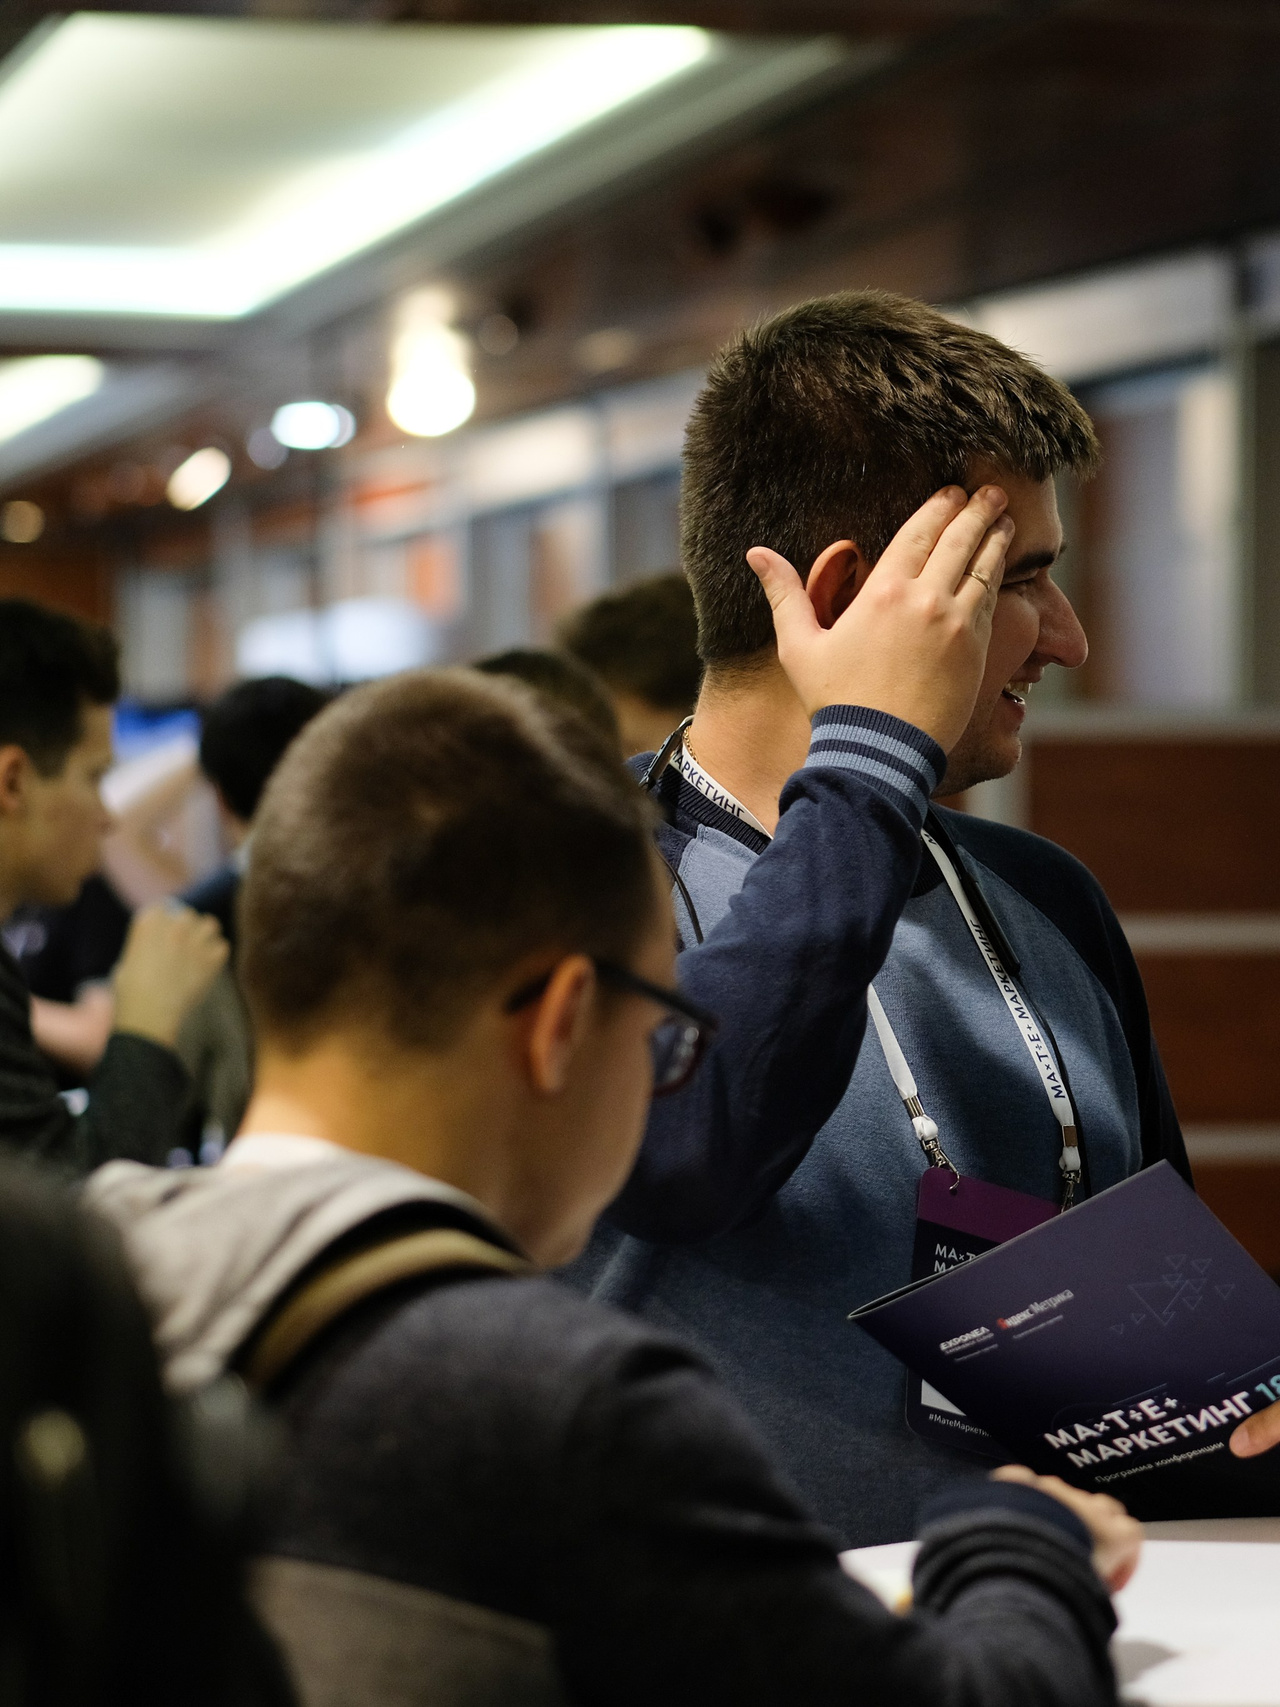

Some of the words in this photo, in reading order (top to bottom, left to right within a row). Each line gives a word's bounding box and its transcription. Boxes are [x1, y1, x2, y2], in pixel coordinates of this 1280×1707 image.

[970, 919, 1029, 1019] МАРКЕТИНГ
[1067, 1391, 1252, 1468] МАРКЕТИНГ
[1095, 1463, 1154, 1483] Программа
[1155, 1442, 1225, 1467] конференции
